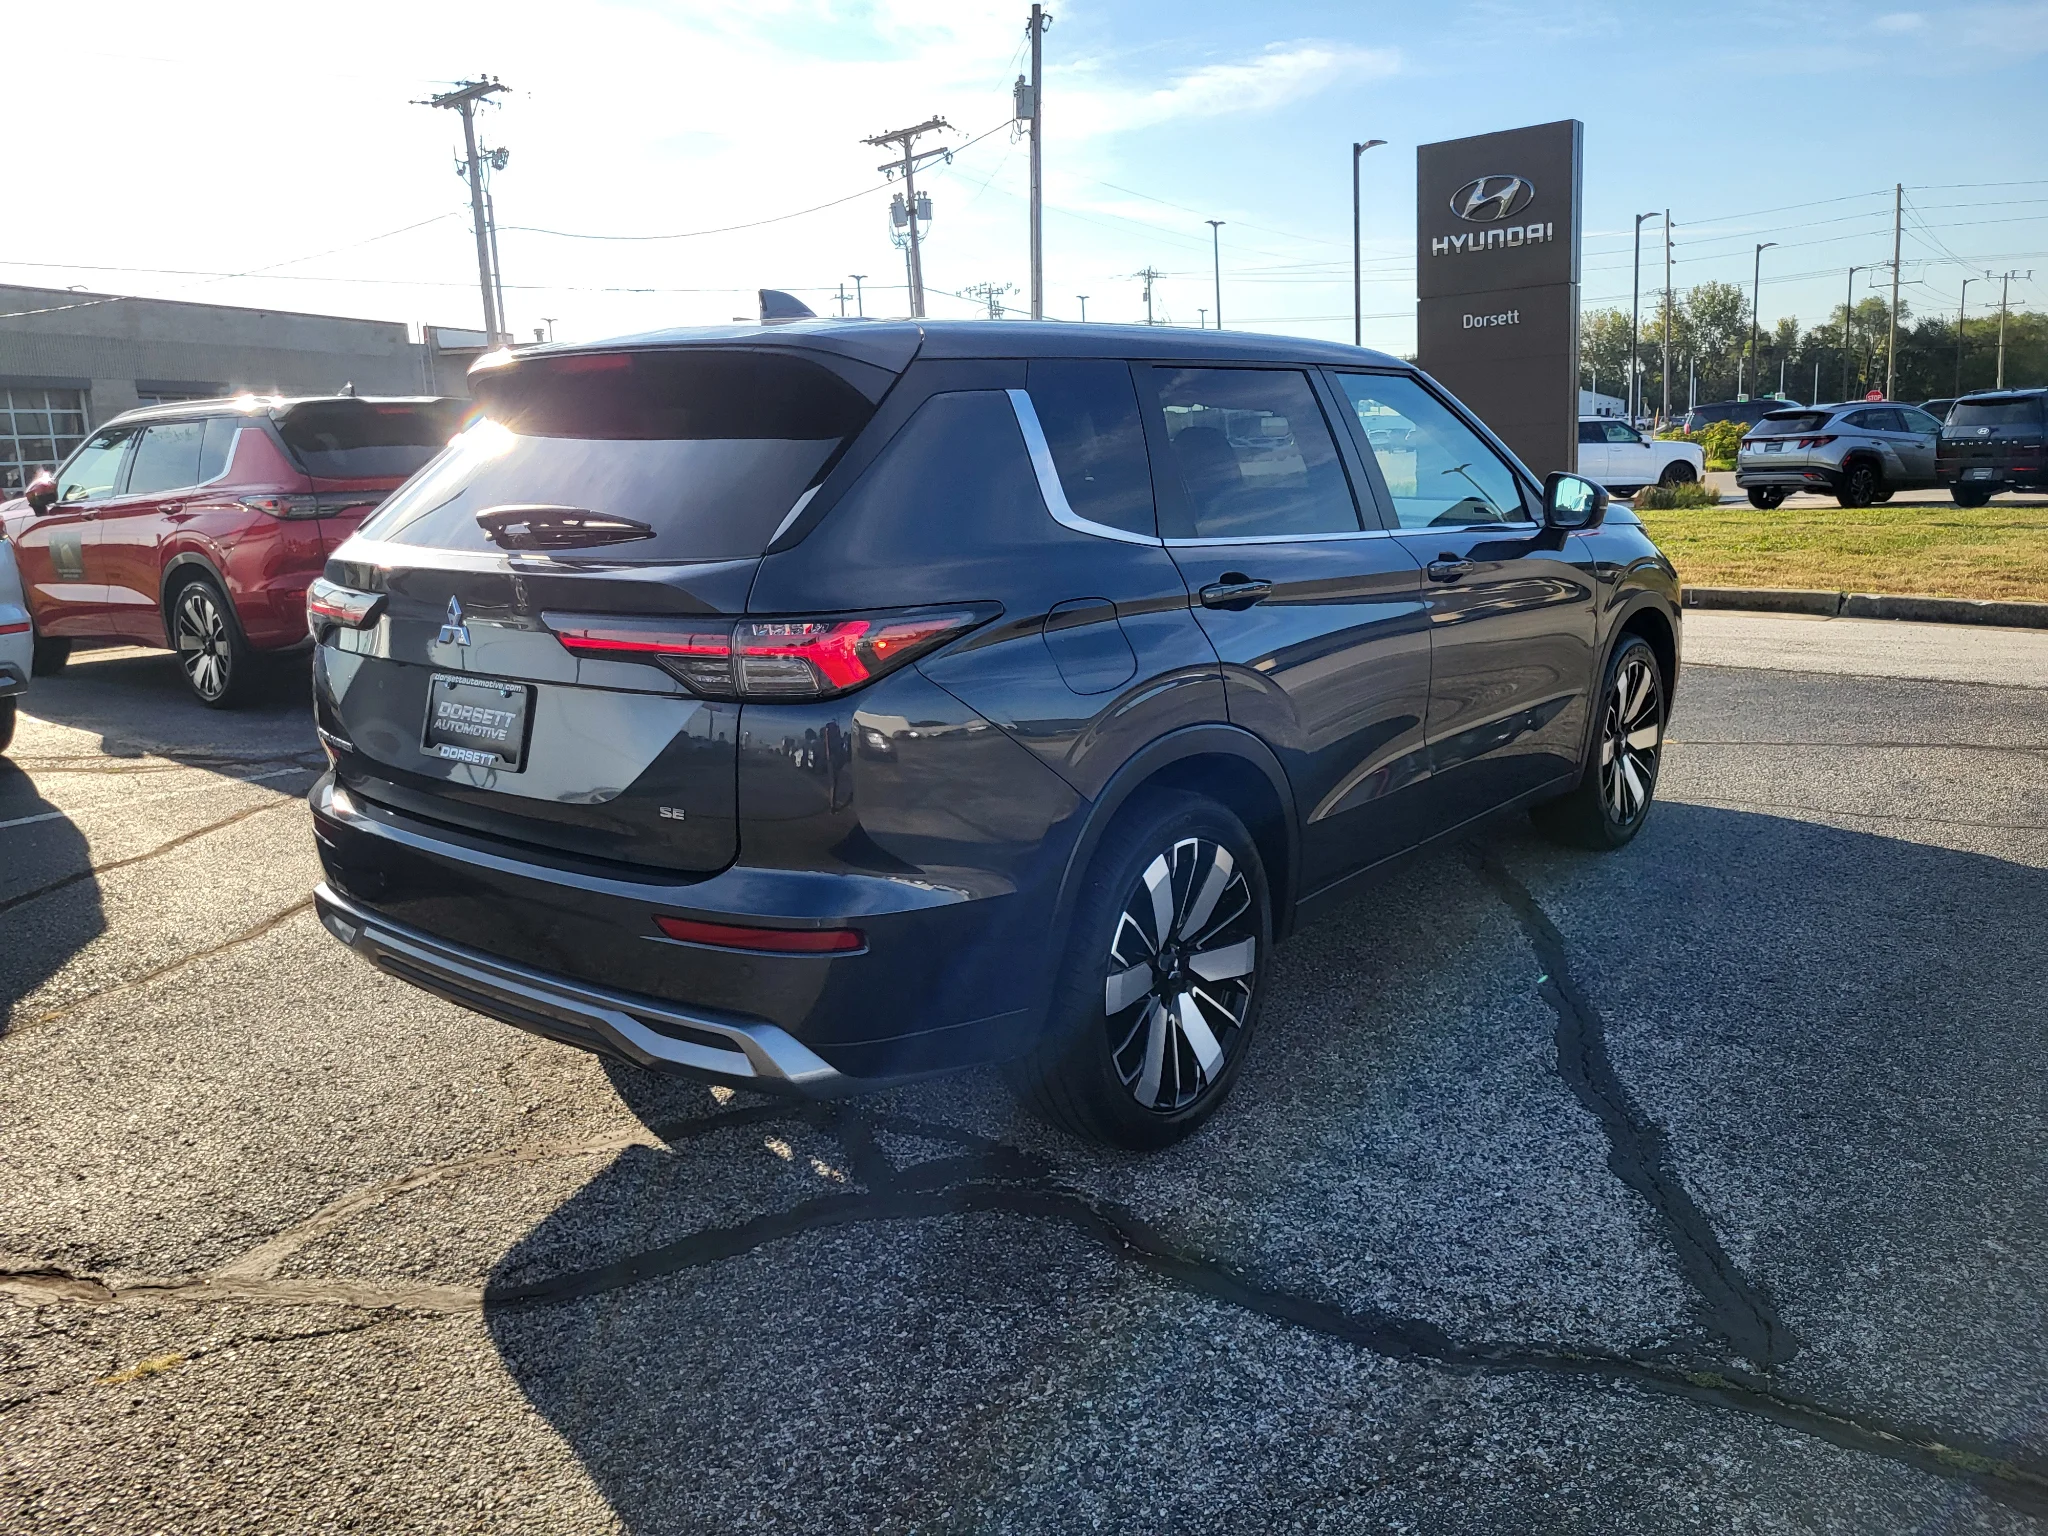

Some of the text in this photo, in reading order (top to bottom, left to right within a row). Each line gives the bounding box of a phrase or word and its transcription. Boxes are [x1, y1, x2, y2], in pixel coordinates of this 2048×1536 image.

[1432, 222, 1553, 257] HYUNDAI
[1463, 309, 1520, 329] Dorsett
[434, 672, 522, 692] dorsettautomotive.com
[437, 701, 516, 728] DORSETT
[433, 718, 508, 740] AUTOMOTIVE
[440, 746, 496, 766] DORSETT
[659, 806, 685, 820] SE
